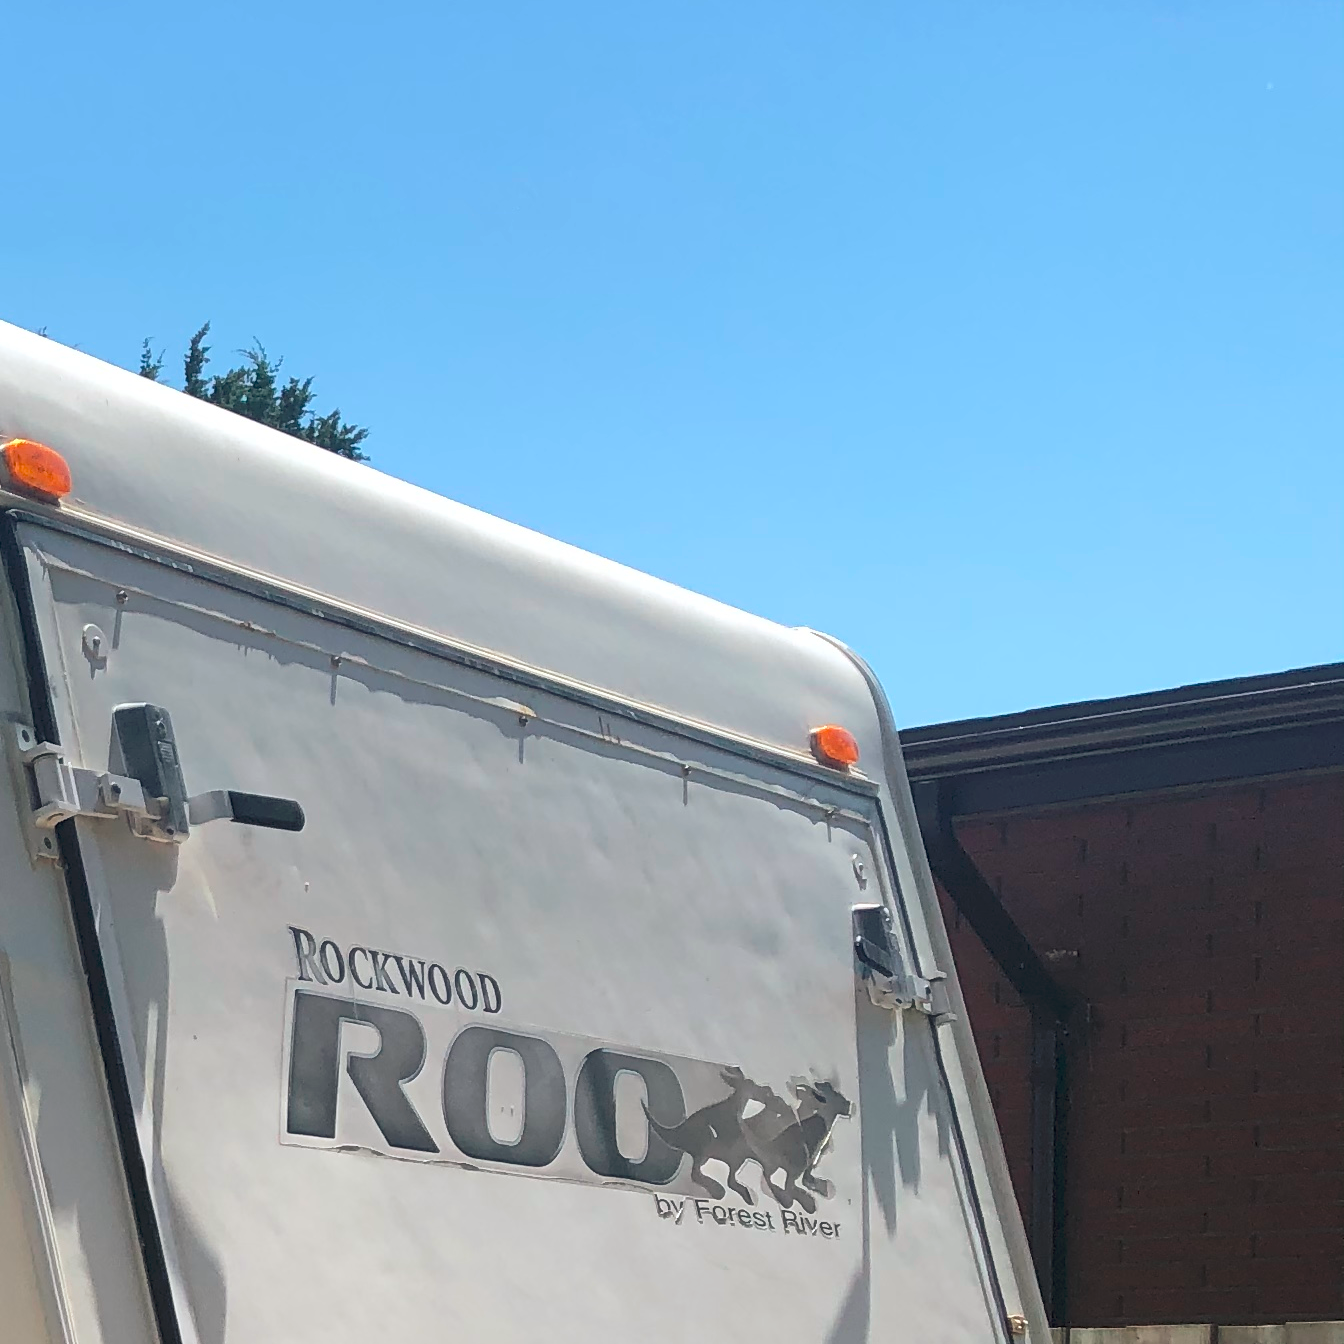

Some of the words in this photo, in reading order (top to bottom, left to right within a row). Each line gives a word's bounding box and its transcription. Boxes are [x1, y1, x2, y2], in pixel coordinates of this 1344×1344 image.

[288, 925, 503, 1016] ROCKWOOD
[285, 987, 688, 1186] ROO
[654, 1193, 685, 1226] by
[694, 1199, 776, 1232] Forest
[780, 1208, 842, 1240] River
